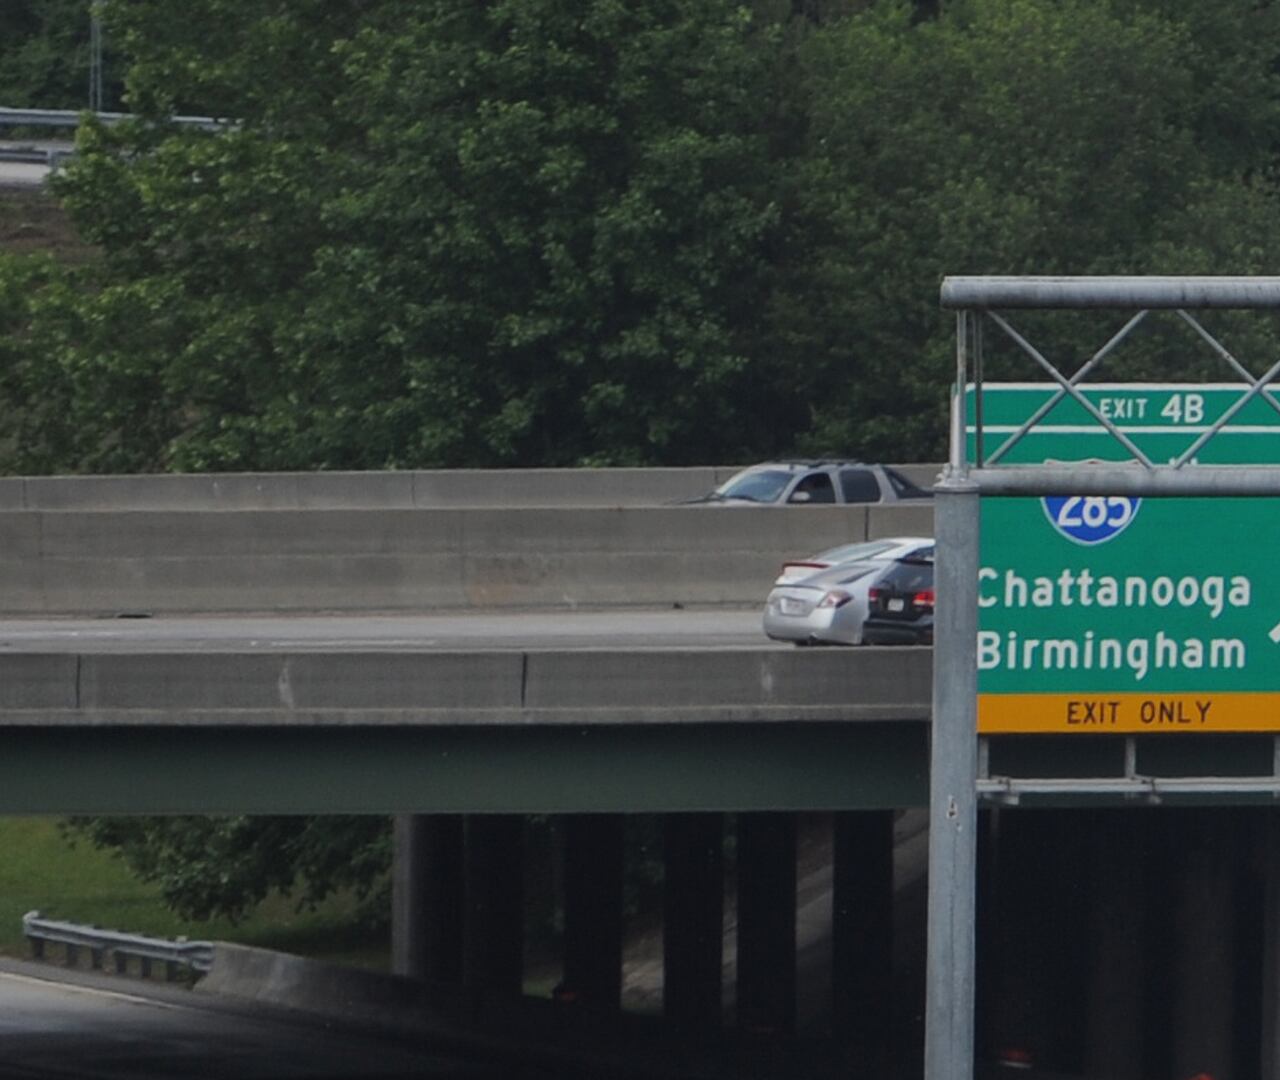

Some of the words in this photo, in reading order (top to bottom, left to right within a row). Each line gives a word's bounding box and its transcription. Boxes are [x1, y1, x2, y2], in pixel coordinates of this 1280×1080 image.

[1100, 398, 1148, 419] EXIT
[1160, 394, 1204, 423] 4B
[978, 567, 1250, 618] Chattanooga
[976, 630, 1246, 680] Birmingham
[1067, 701, 1120, 724] EXIT
[1140, 701, 1212, 724] ONLY
